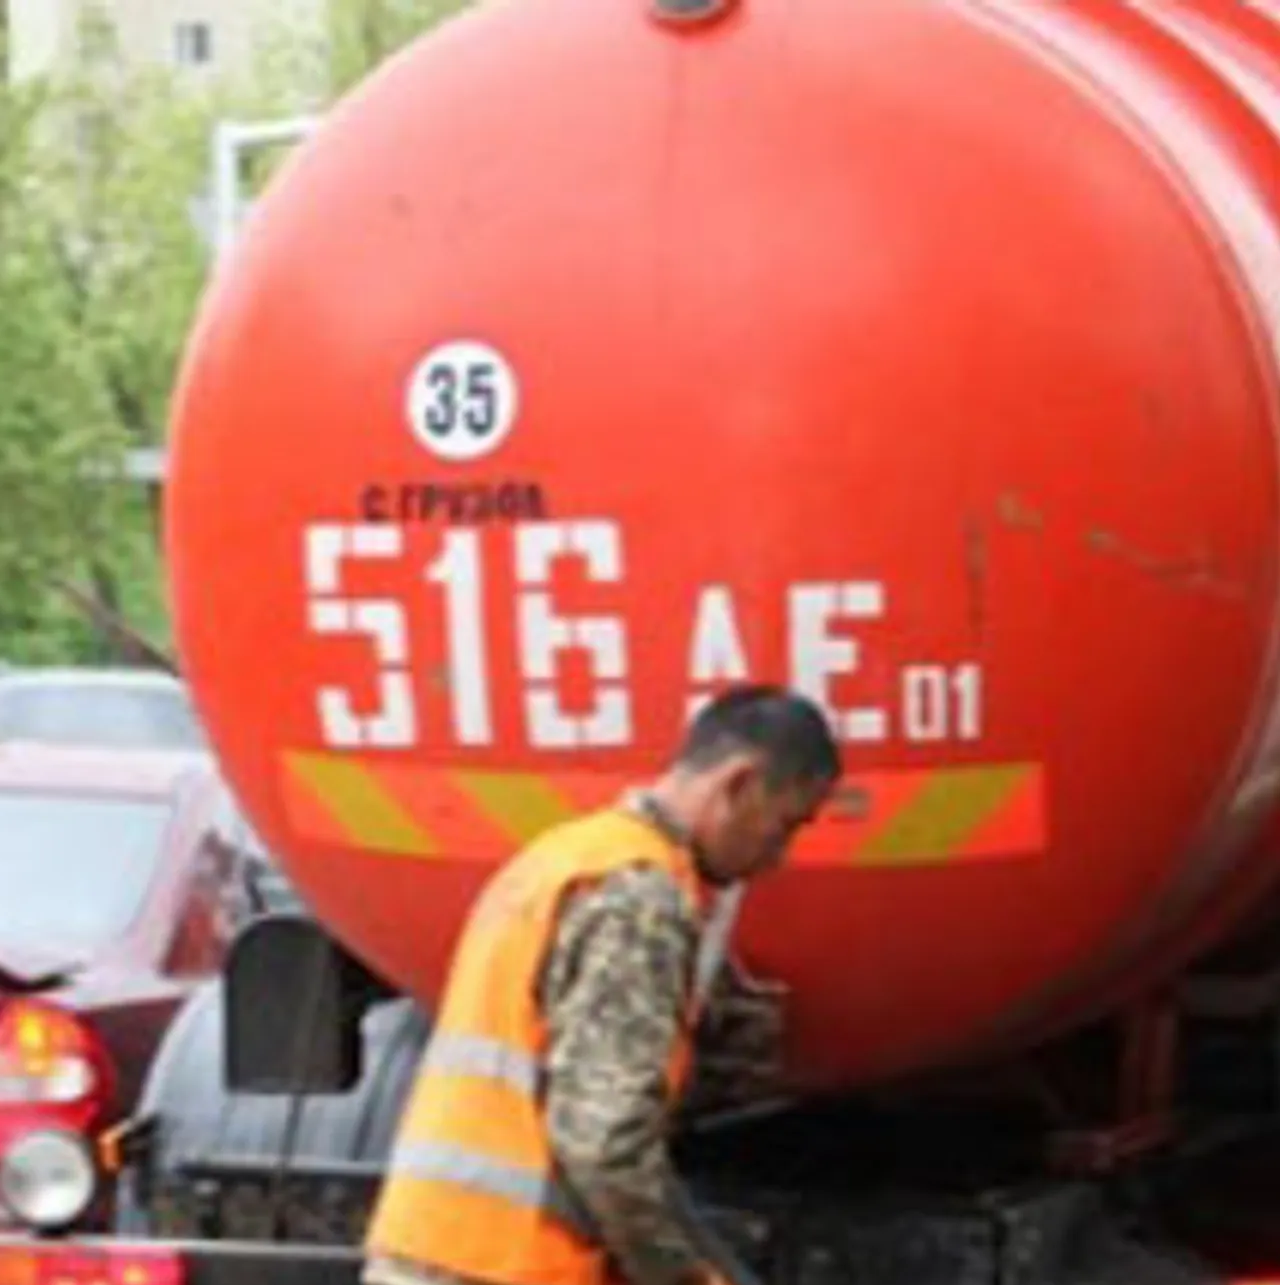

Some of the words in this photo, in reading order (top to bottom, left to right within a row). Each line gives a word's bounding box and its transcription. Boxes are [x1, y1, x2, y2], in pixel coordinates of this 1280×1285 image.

[424, 364, 499, 438] 35
[306, 521, 632, 750] 516
[902, 664, 982, 742] 01
